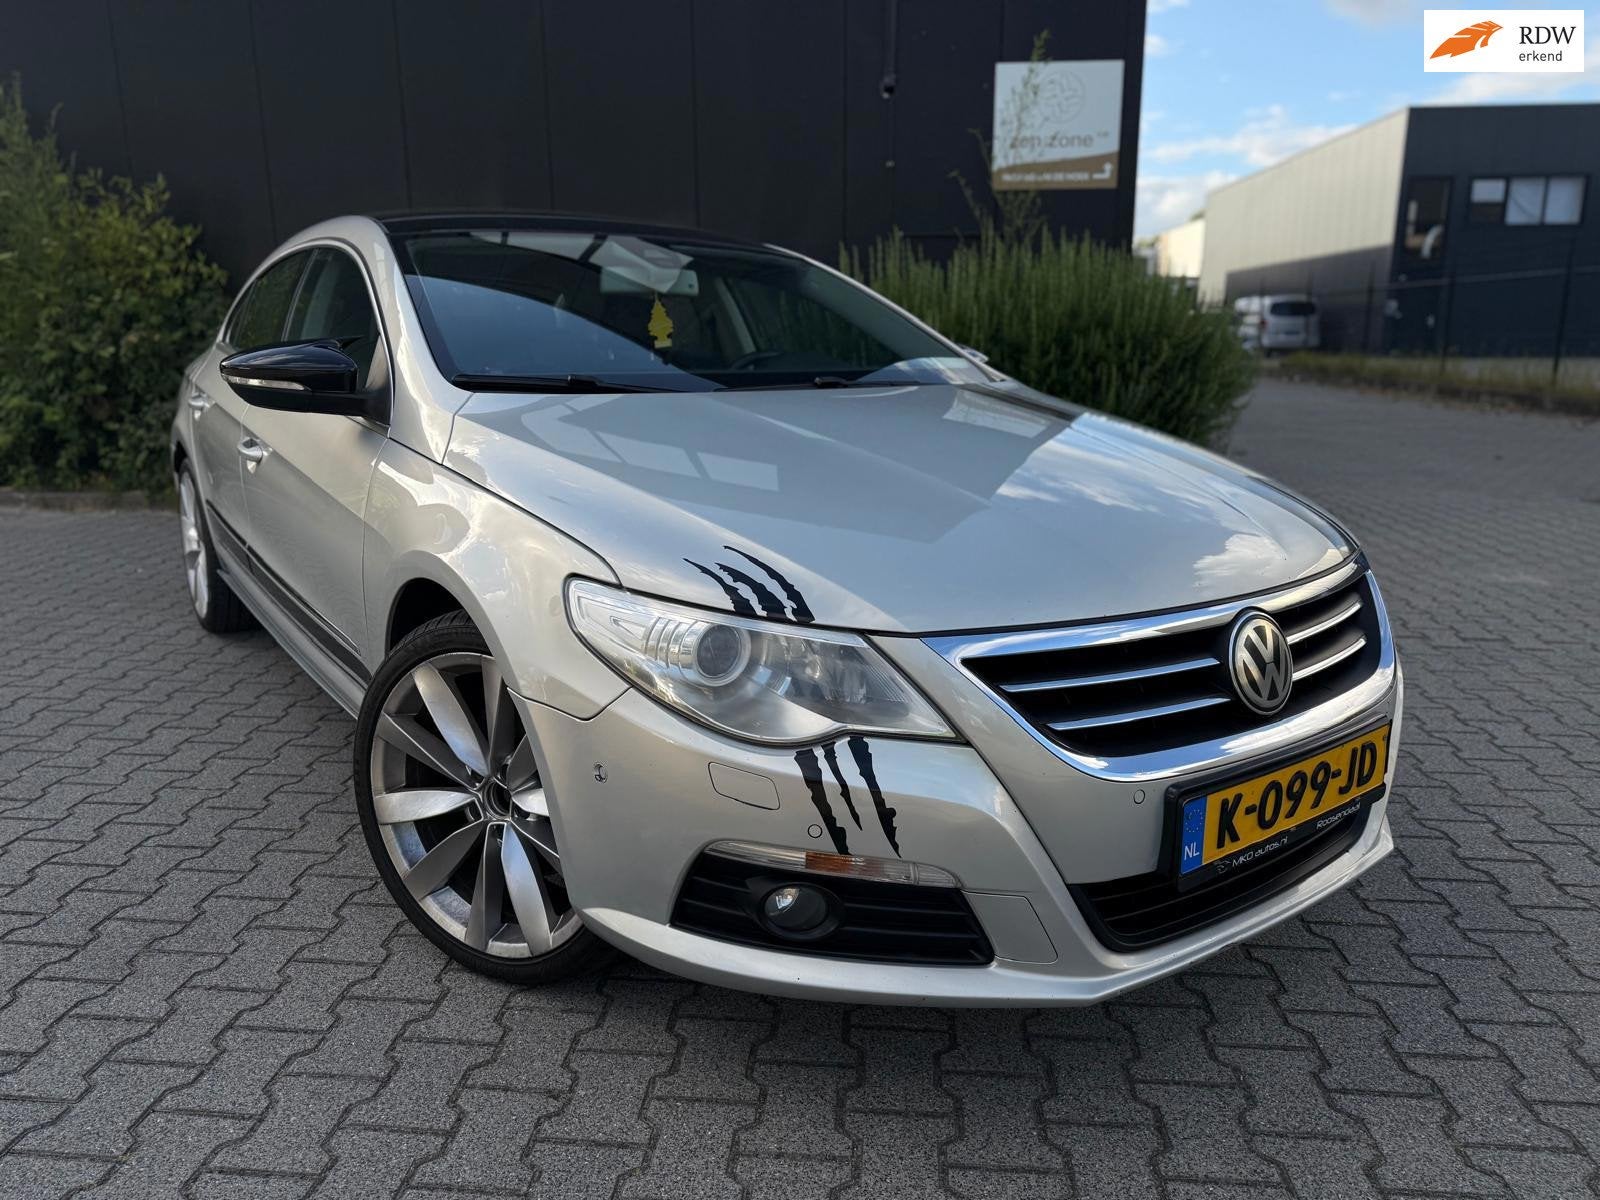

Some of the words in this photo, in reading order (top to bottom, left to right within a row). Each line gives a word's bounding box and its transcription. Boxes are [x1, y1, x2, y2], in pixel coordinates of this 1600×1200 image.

[1231, 612, 1292, 713] VW
[1216, 741, 1377, 849] K-099-JD
[1316, 802, 1361, 830] Roosendaal
[1184, 841, 1200, 860] NL
[1254, 836, 1289, 858] autos.nl
